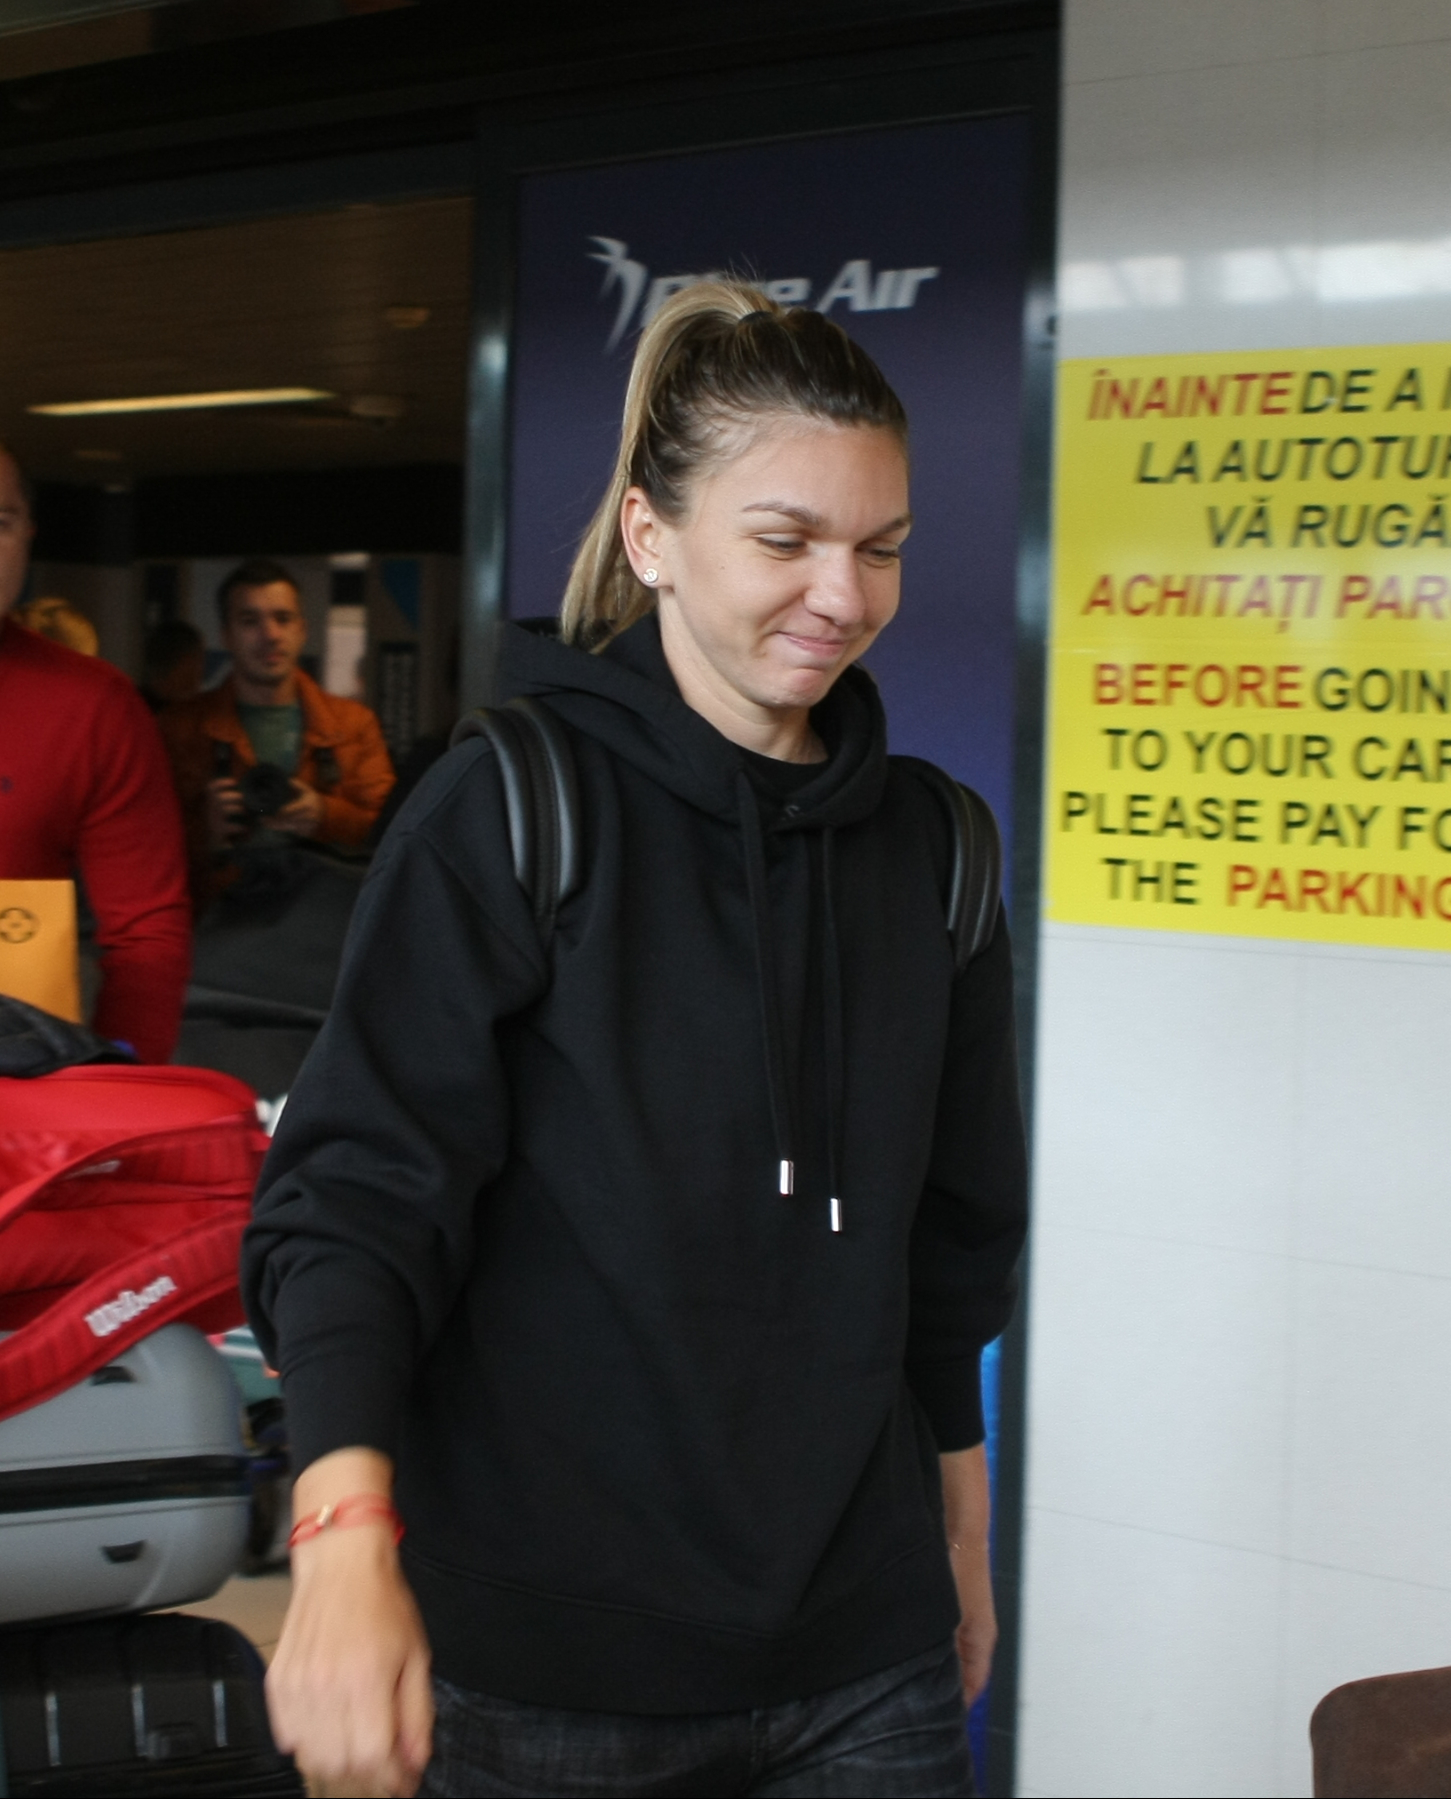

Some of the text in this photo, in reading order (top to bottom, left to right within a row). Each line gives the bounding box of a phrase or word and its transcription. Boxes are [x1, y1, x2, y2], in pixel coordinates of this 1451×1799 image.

[814, 259, 940, 312] Air
[1086, 369, 1295, 420] ÎNAINTE
[1299, 368, 1377, 414] DE
[1385, 367, 1423, 412] A
[1134, 440, 1201, 484] LA
[1207, 494, 1274, 548] VĂ
[1334, 575, 1450, 620] PAR
[1093, 663, 1451, 713] BEFORE GOIN
[1102, 728, 1169, 771] TO
[1184, 730, 1333, 778] YOUR
[1062, 791, 1260, 841] PLEASE
[1278, 801, 1381, 848] PAY
[1101, 857, 1200, 905] THE
